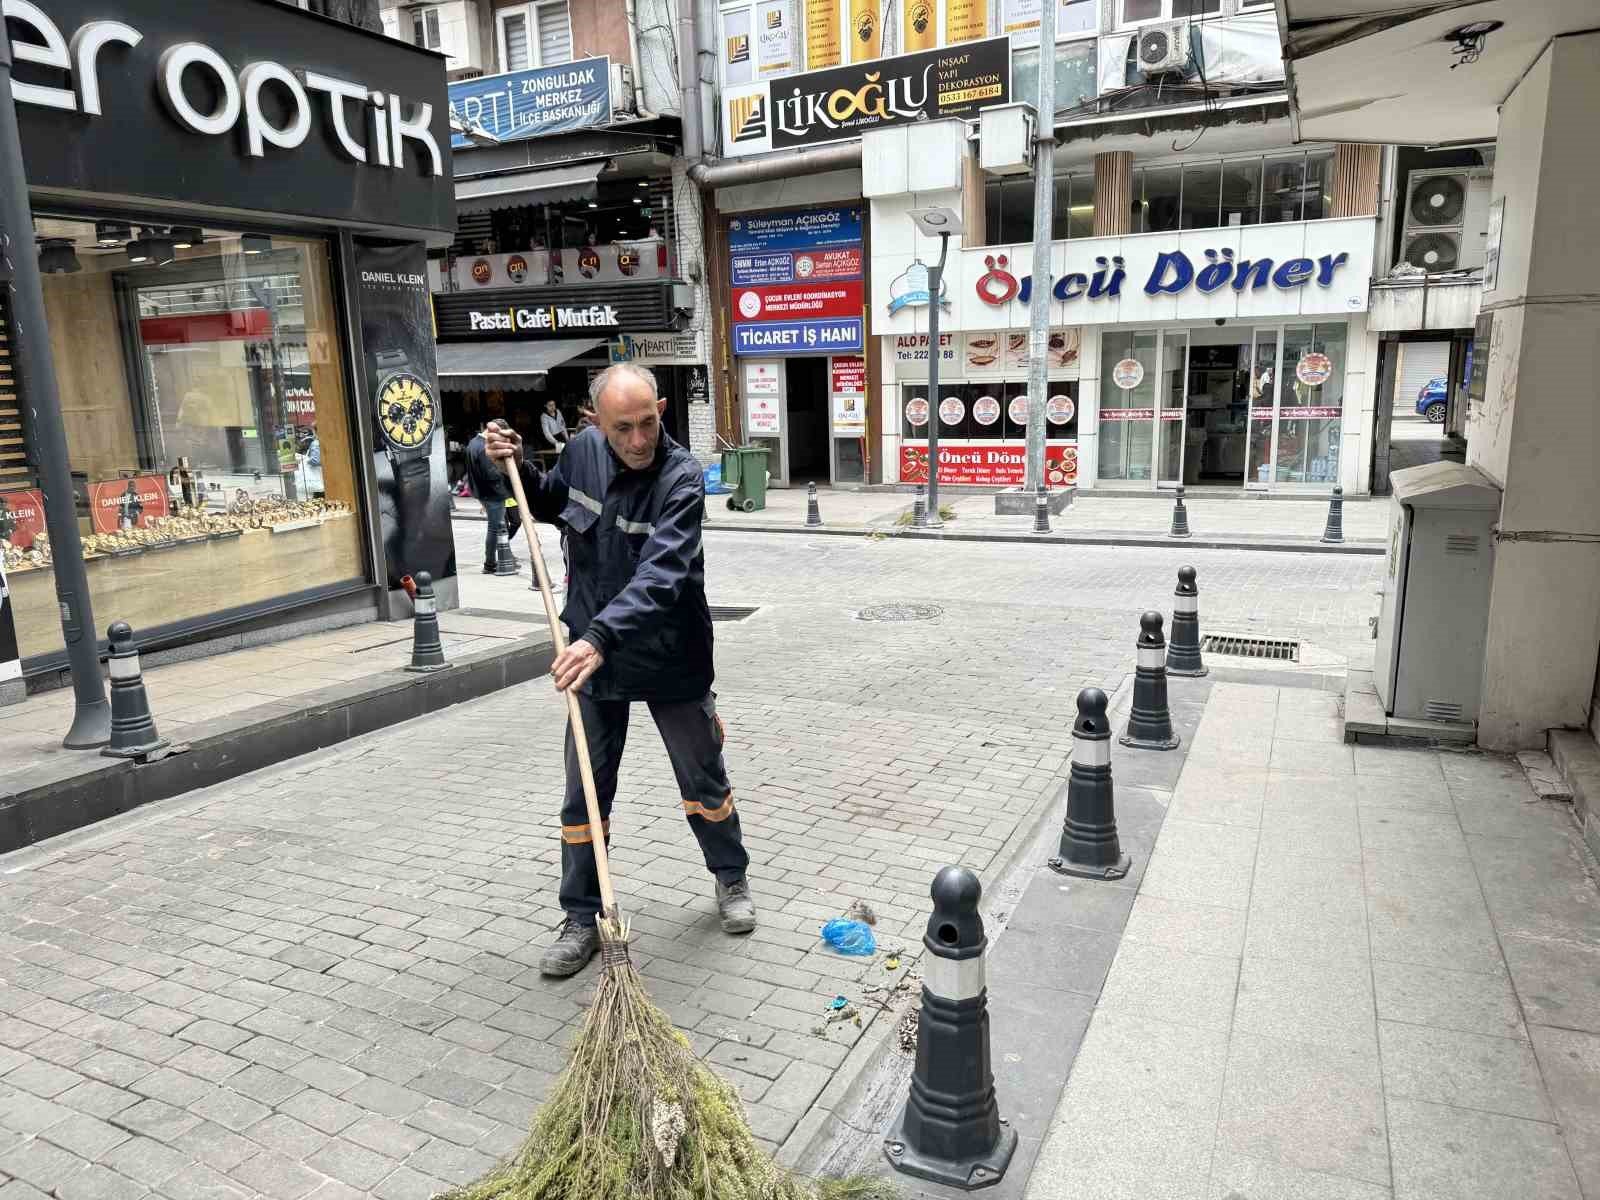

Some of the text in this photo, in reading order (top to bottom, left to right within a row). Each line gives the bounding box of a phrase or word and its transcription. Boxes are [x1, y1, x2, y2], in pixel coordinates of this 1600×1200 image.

[521, 69, 595, 94] ZONGULDAK
[939, 69, 958, 80] YAPI
[938, 73, 1000, 92] DEKORASYON
[535, 89, 582, 108] MERKEZ
[775, 64, 935, 135] LİKOĞLU
[520, 102, 601, 126] İLÇE BAŞKANLIĞI
[795, 213, 840, 225] AÇIKGÖZ
[824, 251, 850, 260] AVUKAT
[361, 271, 424, 285] DANIEL KLEIN
[1143, 247, 1349, 296] Döner
[469, 305, 619, 330] Pasta Cafe Mutfak
[741, 325, 856, 346] TİCARET İŞ HANI
[897, 335, 917, 347] ALO
[648, 339, 673, 353] PARTİ
[914, 350, 928, 359] 222
[939, 448, 982, 464] Öncü
[101, 492, 160, 507] DANIEL KLEIN
[5, 508, 35, 520] KLEIN
